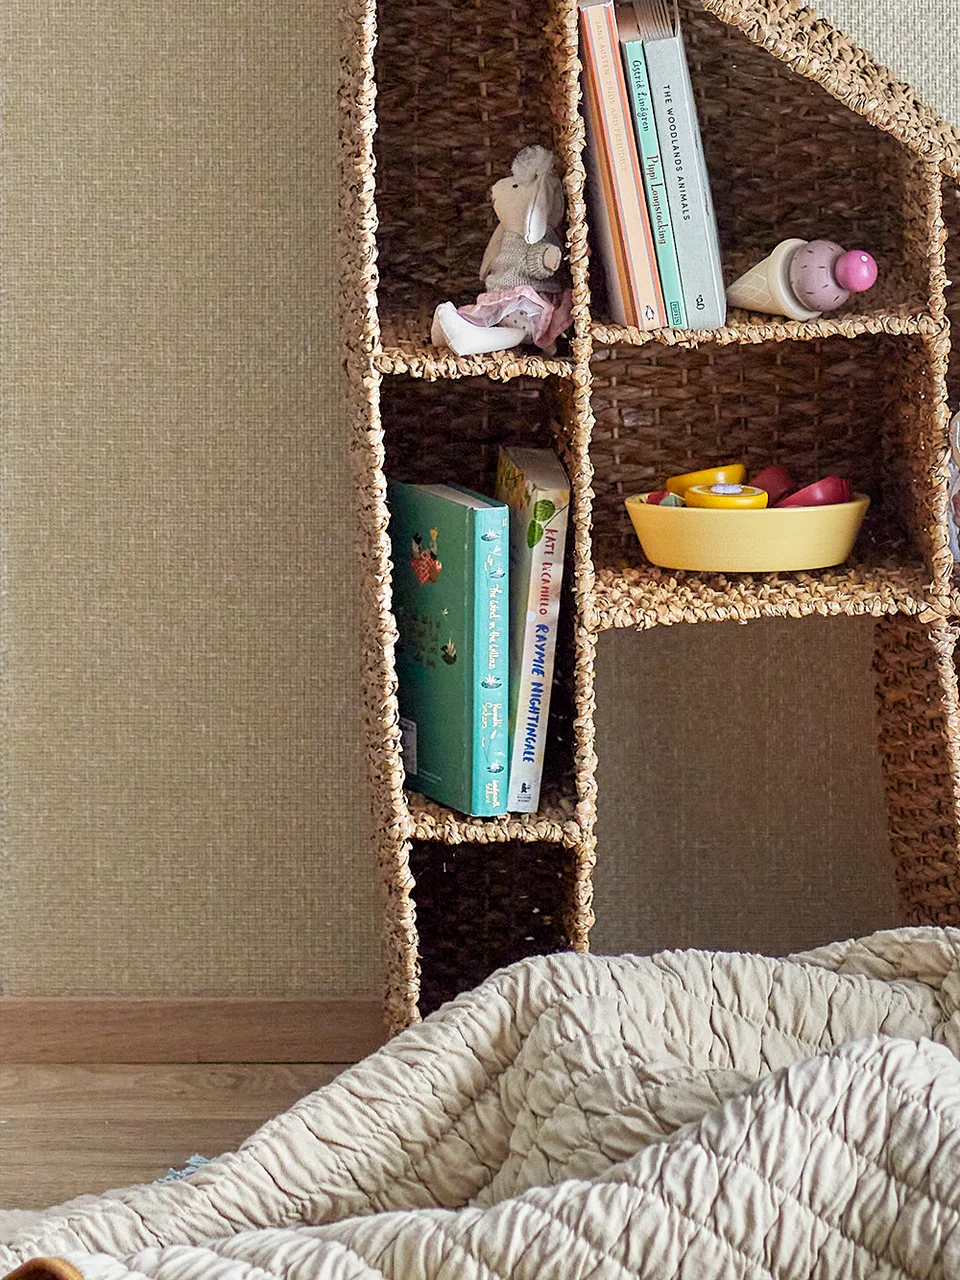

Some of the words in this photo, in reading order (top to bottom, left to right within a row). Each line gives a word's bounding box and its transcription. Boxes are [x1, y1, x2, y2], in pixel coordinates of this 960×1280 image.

[600, 44, 610, 75] AUSTEN
[636, 91, 649, 132] Lindgren
[663, 84, 673, 104] THE
[666, 107, 683, 172] WOODLANDS
[646, 155, 659, 180] Pippi
[650, 182, 669, 245] Longstocking
[677, 176, 691, 221] ANIMALS
[544, 528, 558, 556] KATE
[531, 624, 550, 677] RAYMIE
[522, 682, 544, 763] NIGHTINGALE
